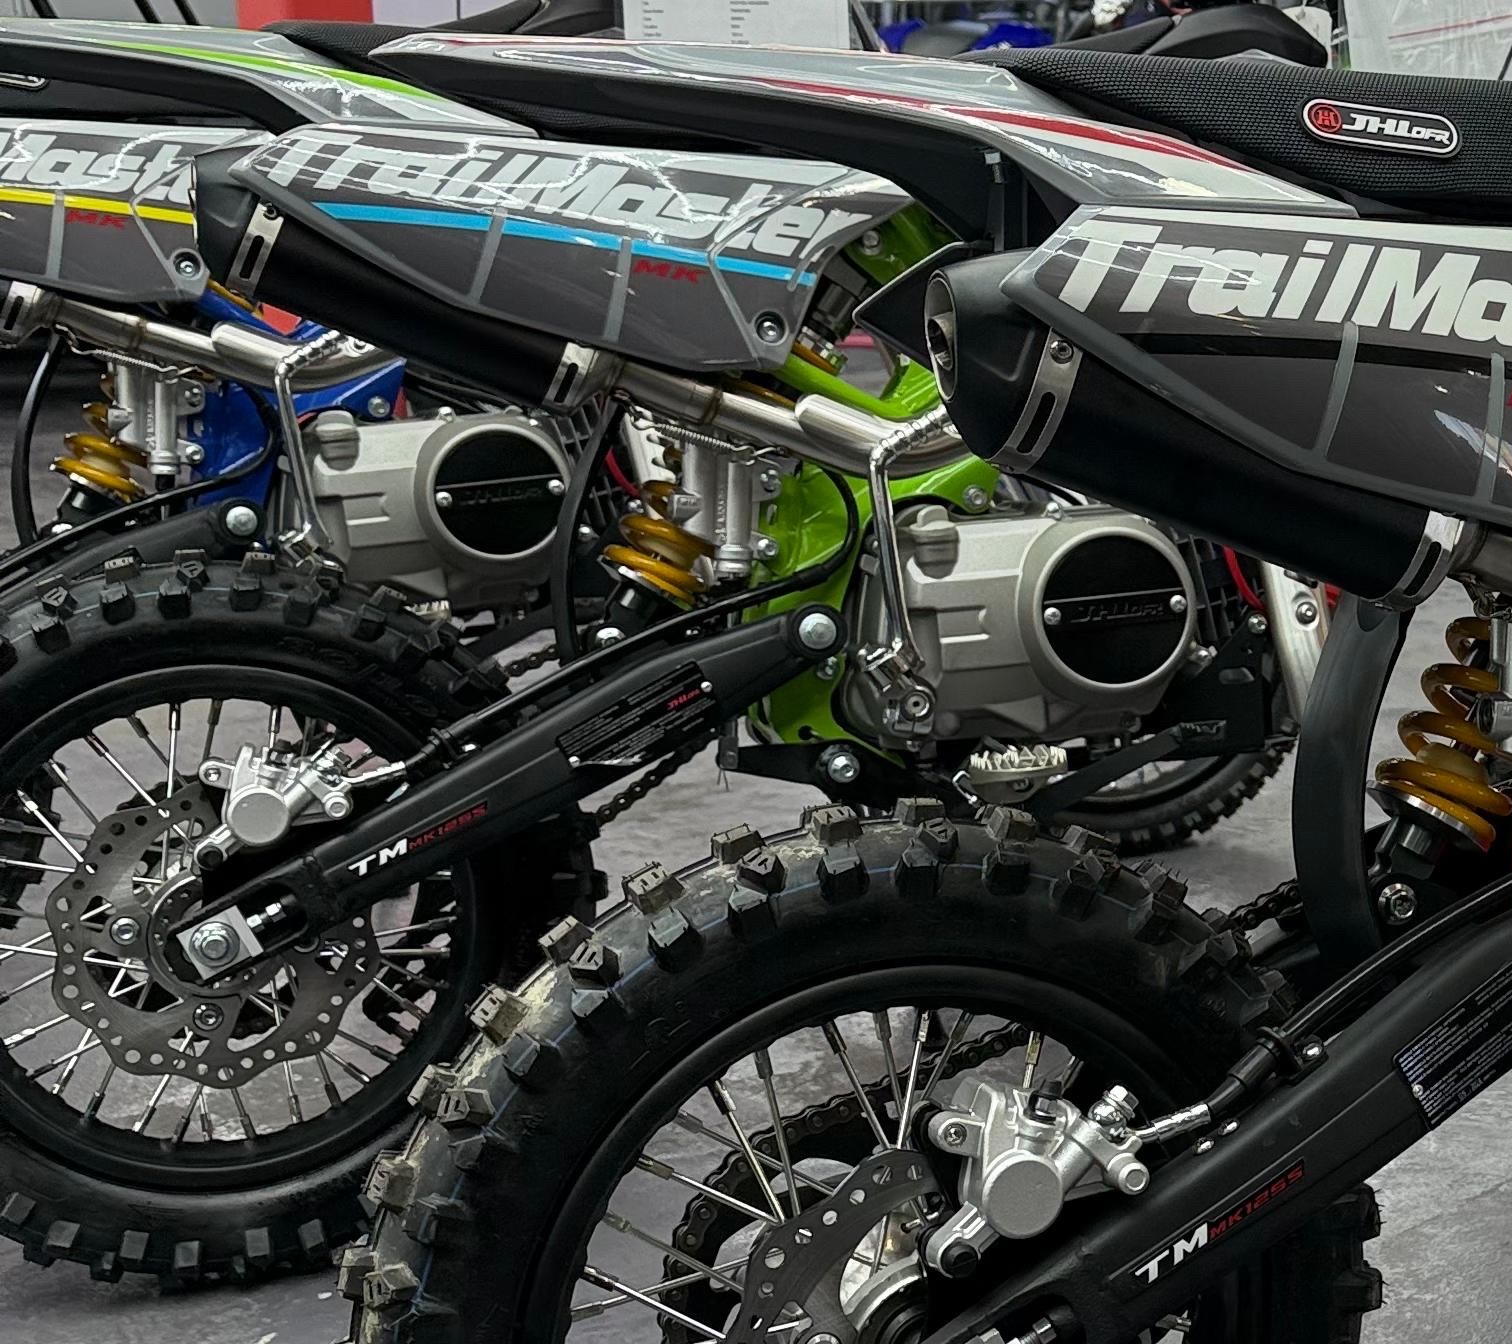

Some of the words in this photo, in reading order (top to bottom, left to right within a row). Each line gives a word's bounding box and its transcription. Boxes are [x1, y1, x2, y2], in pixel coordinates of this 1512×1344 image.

[268, 135, 873, 260] TrailMaster
[632, 258, 708, 284] MK
[348, 837, 408, 876] TM
[1134, 1222, 1208, 1284] TM
